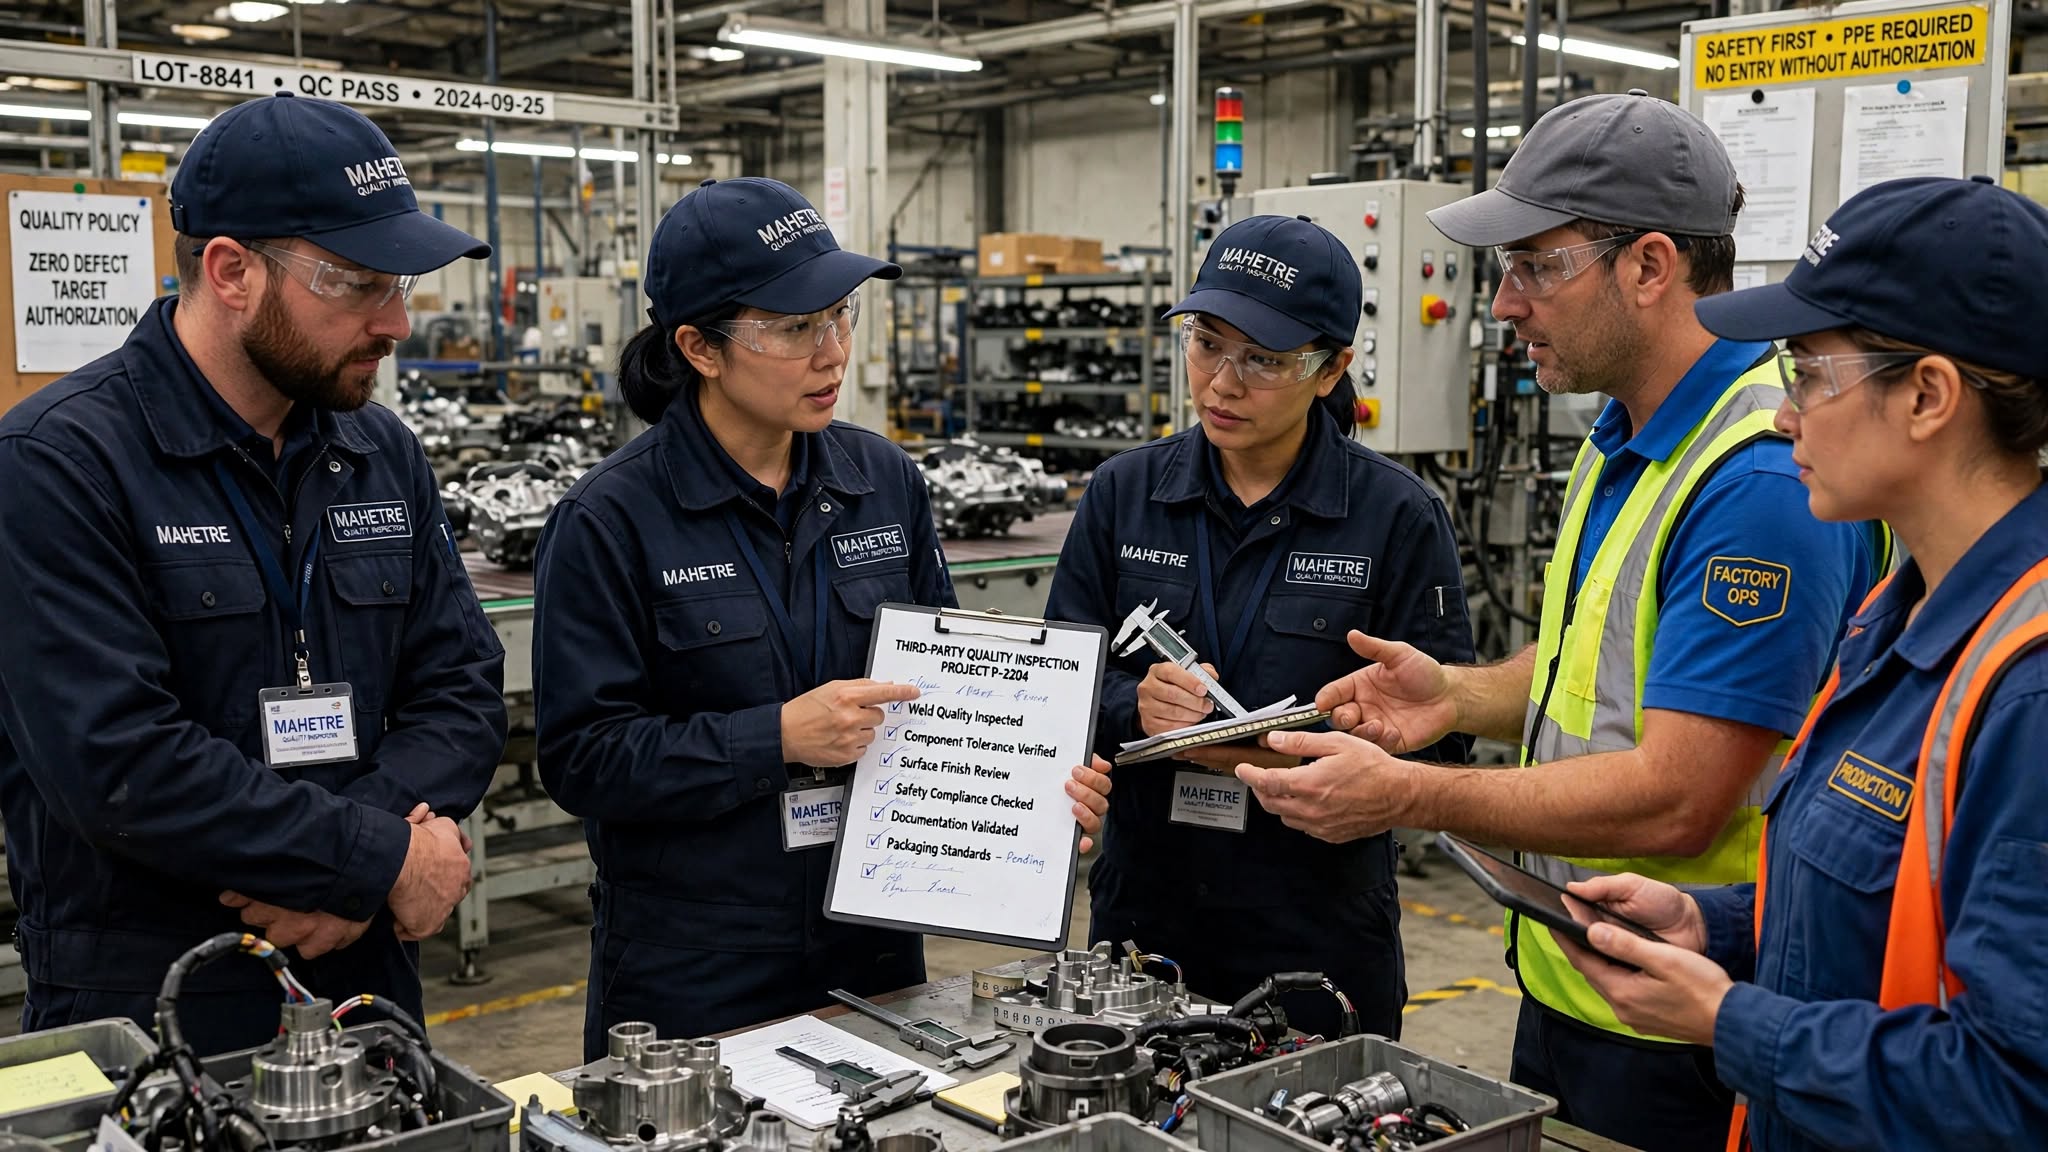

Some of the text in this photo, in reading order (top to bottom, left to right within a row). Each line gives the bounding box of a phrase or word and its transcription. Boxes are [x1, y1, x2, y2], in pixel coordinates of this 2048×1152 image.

[1706, 14, 1973, 59] SAFETY FIRST PPE REQUIRED
[1706, 40, 1975, 83] NO ENTRY WITHOUT AUTHORIZATION
[141, 59, 545, 115] LOT-8841 QC PASS 2024-09-25
[20, 210, 140, 232] QUALITY POLICY
[29, 253, 128, 274] ZERO DEFECT
[1219, 247, 1299, 284] MAHETRE
[52, 280, 107, 299] TARGET
[25, 306, 138, 326] AUTHORIZATION
[334, 507, 405, 528] MAHETRE
[156, 525, 231, 544] MAHETRE
[837, 530, 901, 554] MAHETRE
[1120, 544, 1189, 568] MAHETRE
[1293, 557, 1365, 576] MAHETRE
[662, 563, 737, 586] MAHETRE
[1713, 565, 1782, 589] FACTORY
[1727, 588, 1759, 606] OPS
[896, 640, 1079, 672] THIRD-PARTY QUALITY INSPECTION
[941, 661, 1029, 682] PROJECT P-2204
[274, 715, 344, 735] MAHETRE
[909, 703, 934, 717] Weld
[937, 707, 972, 725] Quality
[975, 711, 1023, 727] Inspected
[904, 730, 1057, 758] Component Tolerance Verified
[900, 756, 1010, 780] Surface Finish Review
[1180, 785, 1240, 804] MAHETRE
[1837, 761, 1906, 808] PRODUCTION
[895, 783, 927, 800] Safety
[930, 788, 988, 805] Compliance
[991, 795, 1034, 811] Checked
[791, 801, 842, 820] MAHETR
[891, 810, 1018, 836] Documentation Validated
[887, 837, 991, 861] Packaging Standards
[1005, 851, 1045, 873] Pending
